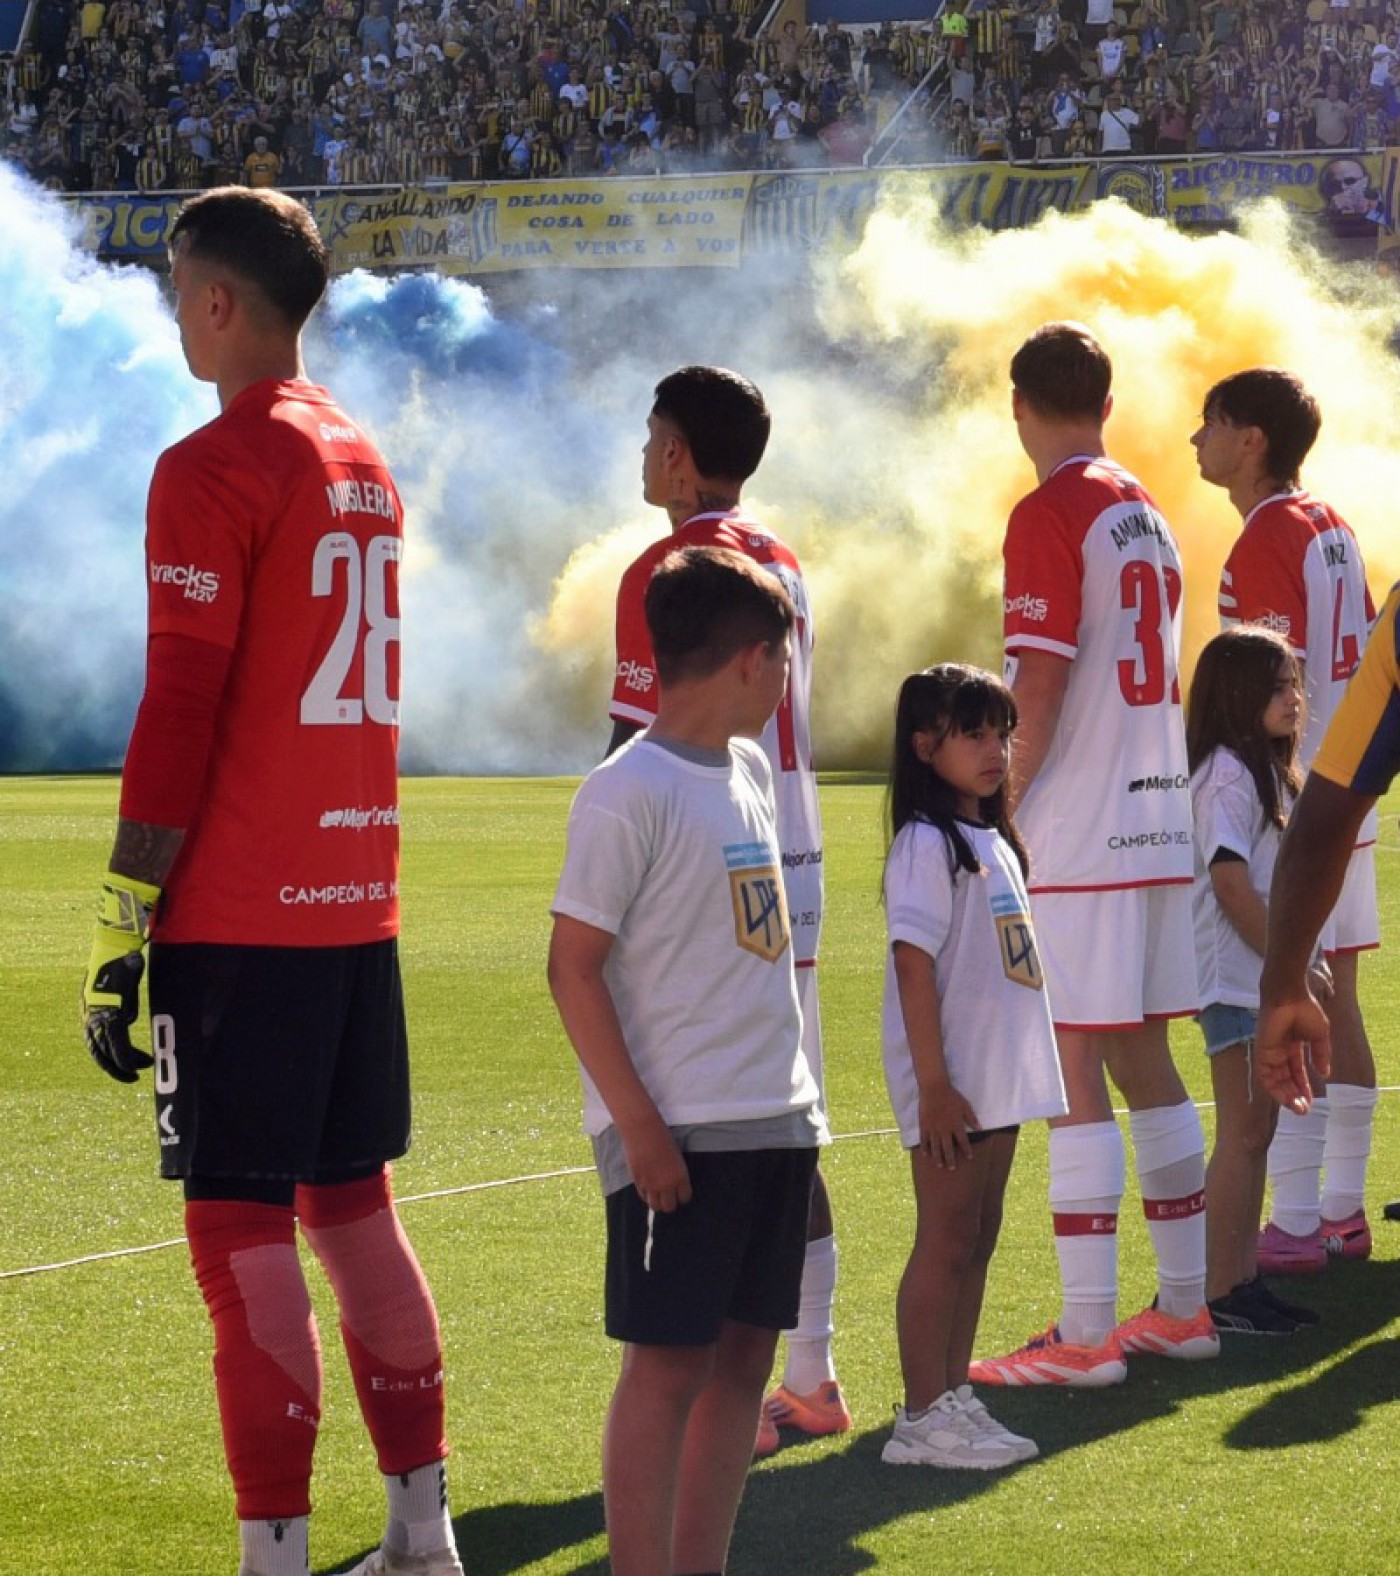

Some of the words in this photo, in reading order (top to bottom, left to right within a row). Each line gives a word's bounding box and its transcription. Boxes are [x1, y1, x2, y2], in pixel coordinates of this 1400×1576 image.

[1172, 158, 1316, 190] RICOTERO
[507, 193, 605, 208] DEJANDO
[627, 187, 745, 205] CUALQUIER
[528, 216, 585, 229] COSA
[606, 213, 634, 228] DE
[656, 211, 716, 226] LADO
[373, 229, 397, 258] LA
[325, 479, 396, 523] MUSLERA
[300, 532, 401, 726] 28
[279, 881, 364, 905] CAMPEÓN
[368, 881, 388, 900] DEL
[152, 1013, 178, 1094] 8
